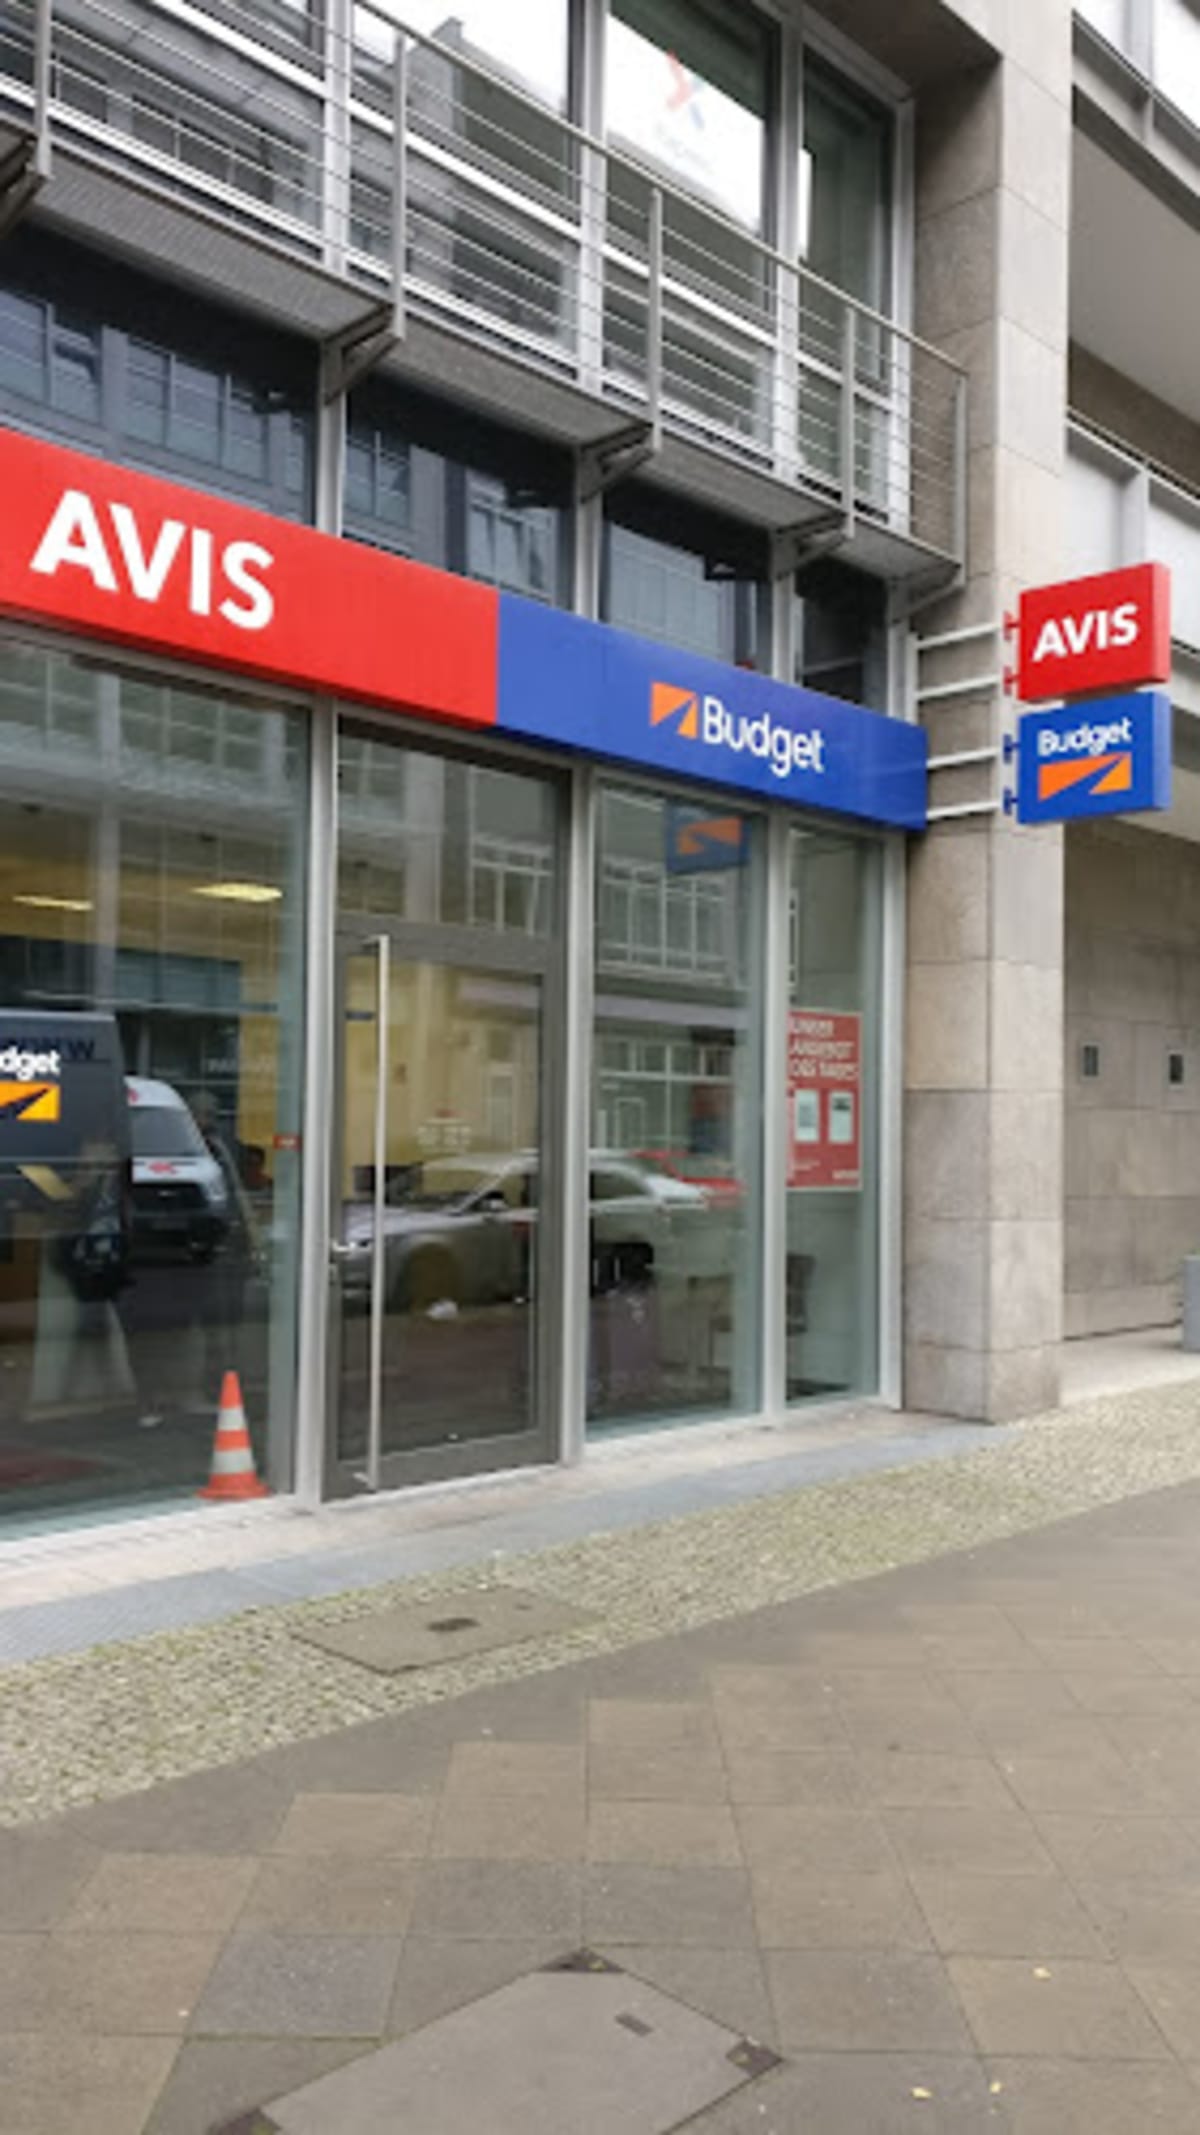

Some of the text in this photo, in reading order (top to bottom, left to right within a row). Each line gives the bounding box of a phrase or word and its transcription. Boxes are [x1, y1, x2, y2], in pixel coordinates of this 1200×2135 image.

[30, 489, 274, 630] AVIS
[1033, 604, 1138, 661] AVIS
[703, 696, 825, 778] Budget
[1037, 716, 1132, 755] Budget
